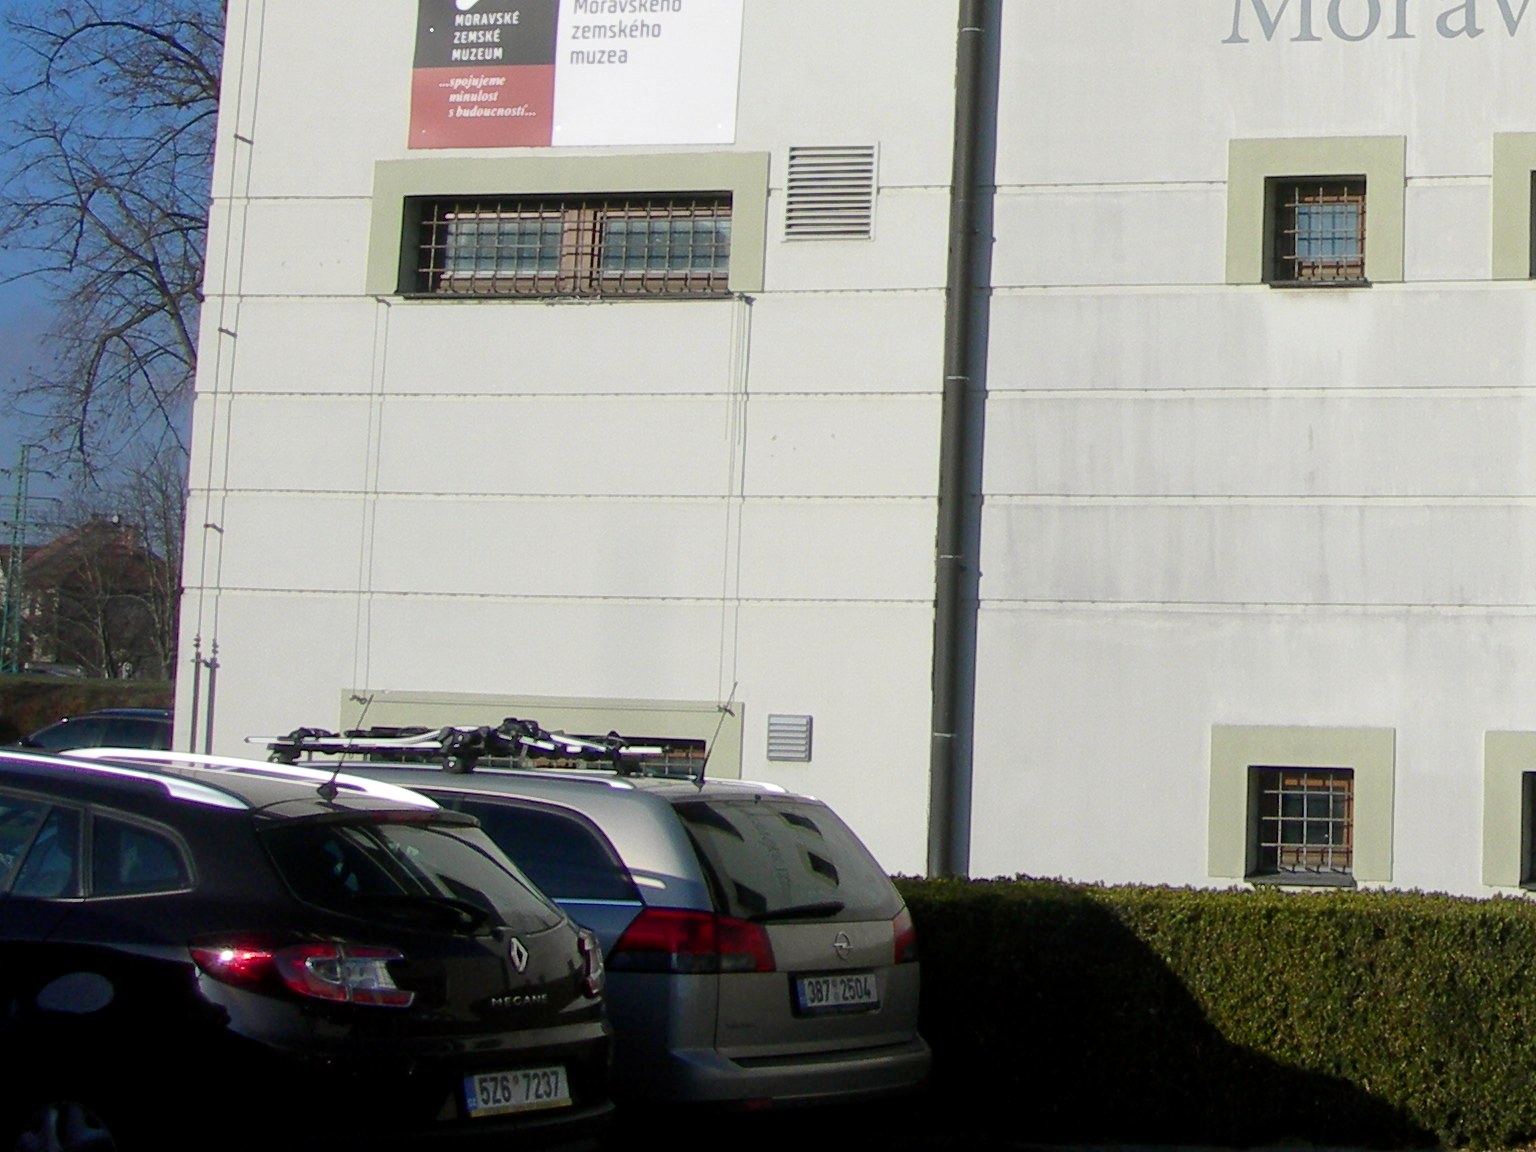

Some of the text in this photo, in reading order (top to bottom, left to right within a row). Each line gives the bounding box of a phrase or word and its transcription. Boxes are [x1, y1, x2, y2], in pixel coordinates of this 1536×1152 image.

[454, 11, 520, 27] MORAVSKÉ
[453, 28, 501, 44] ZEMSKÉ
[571, 18, 662, 40] zemského
[451, 47, 503, 61] MUZEUM
[570, 49, 628, 65] muzea
[448, 90, 499, 103] minulost
[479, 1074, 512, 1105] 5Z6
[522, 1070, 559, 1101] 7237
